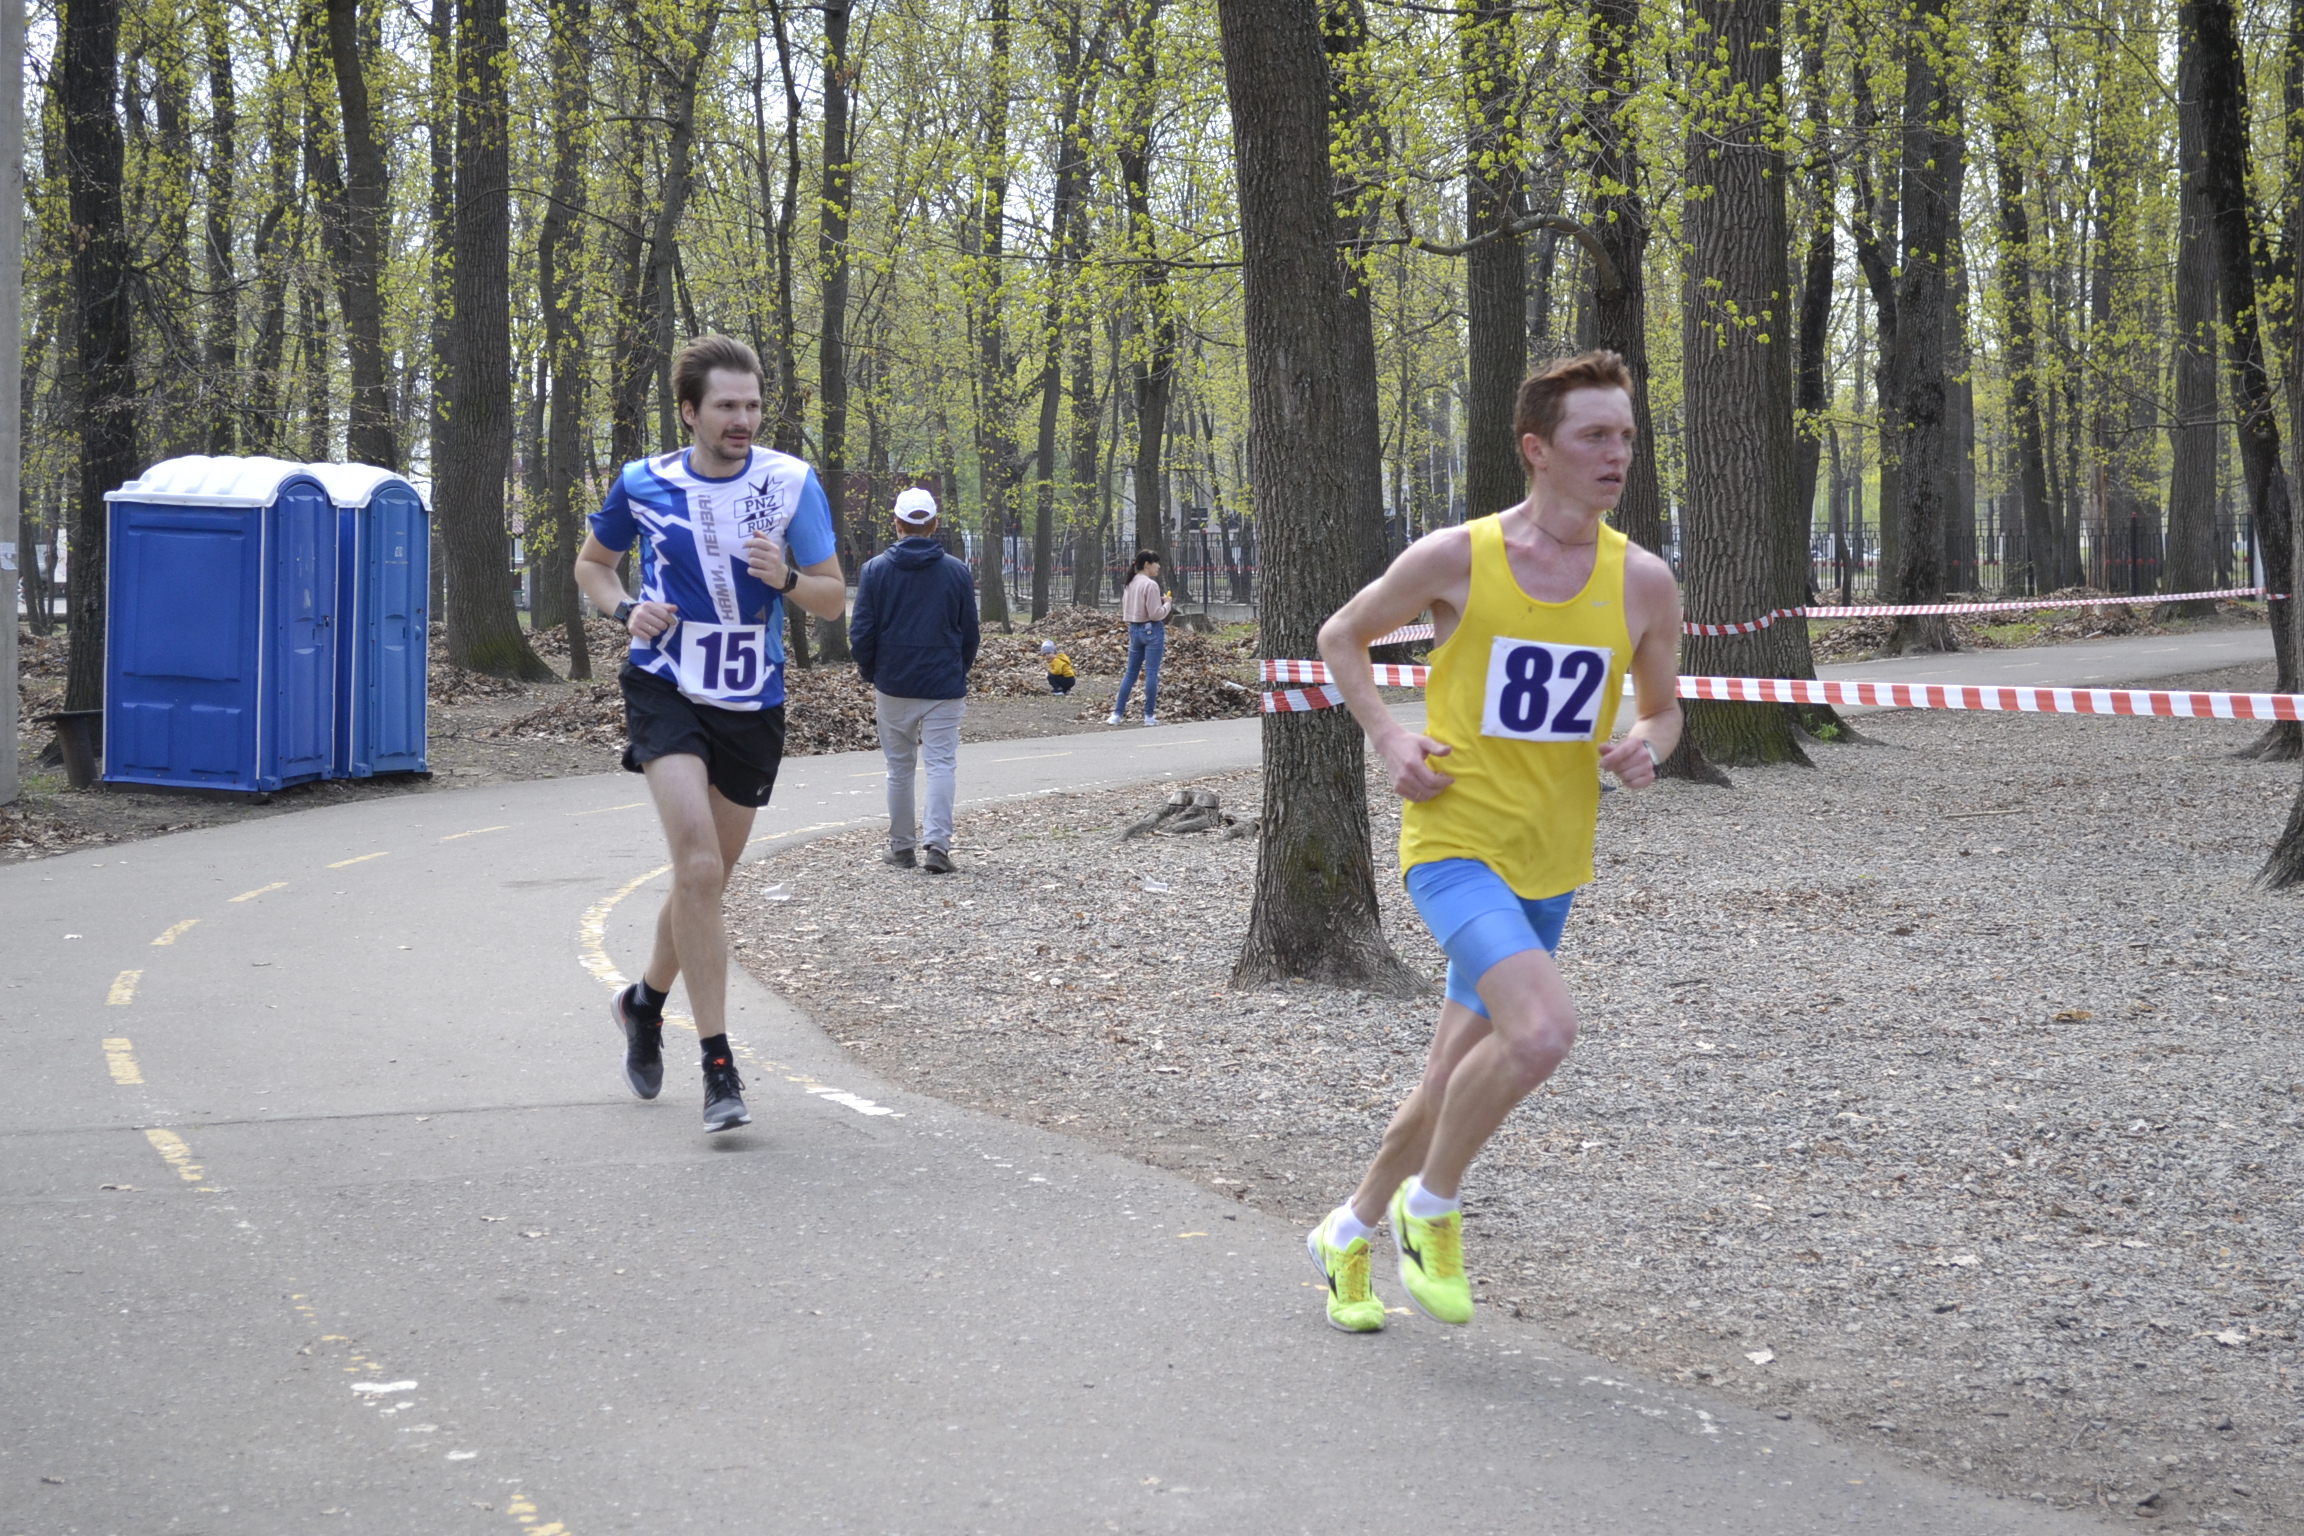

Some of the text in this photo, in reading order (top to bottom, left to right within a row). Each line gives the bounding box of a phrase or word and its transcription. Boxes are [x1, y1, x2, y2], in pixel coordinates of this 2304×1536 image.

[744, 494, 777, 513] PNZ
[746, 516, 775, 534] RUN
[696, 631, 757, 692] 15
[1498, 645, 1605, 733] 82
